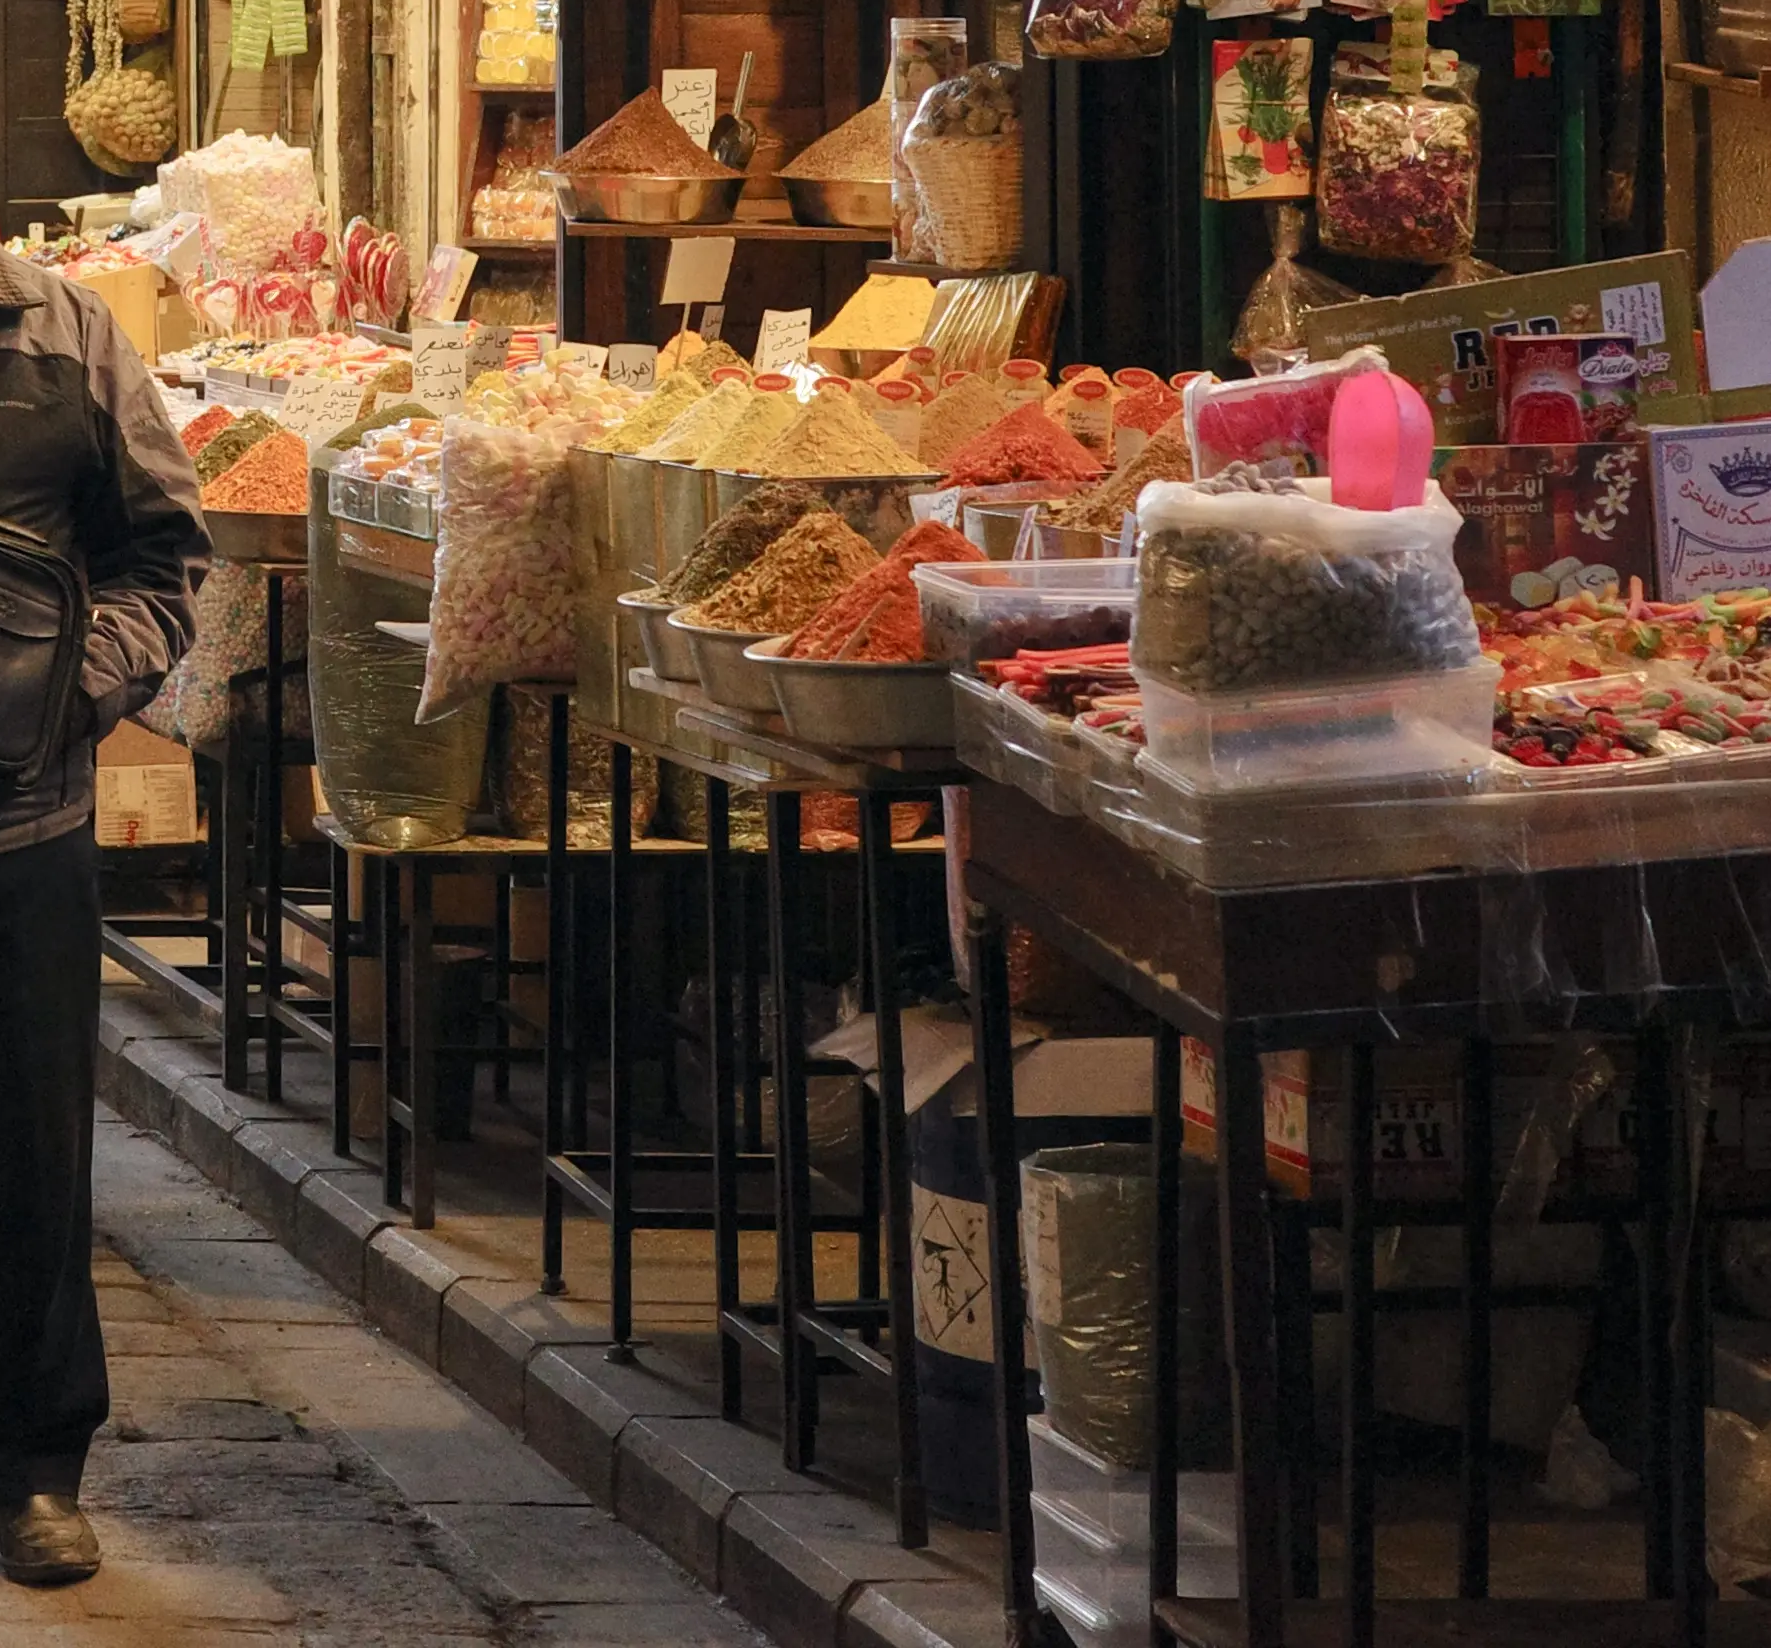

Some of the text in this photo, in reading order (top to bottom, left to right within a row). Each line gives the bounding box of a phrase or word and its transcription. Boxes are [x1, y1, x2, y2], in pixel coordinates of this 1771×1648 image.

[663, 79, 713, 104] زعتر
[1325, 334, 1343, 345] The
[1345, 331, 1375, 343] Happy
[417, 338, 464, 364] نعنع
[415, 363, 463, 381] بلدي
[1582, 359, 1634, 378] Diala
